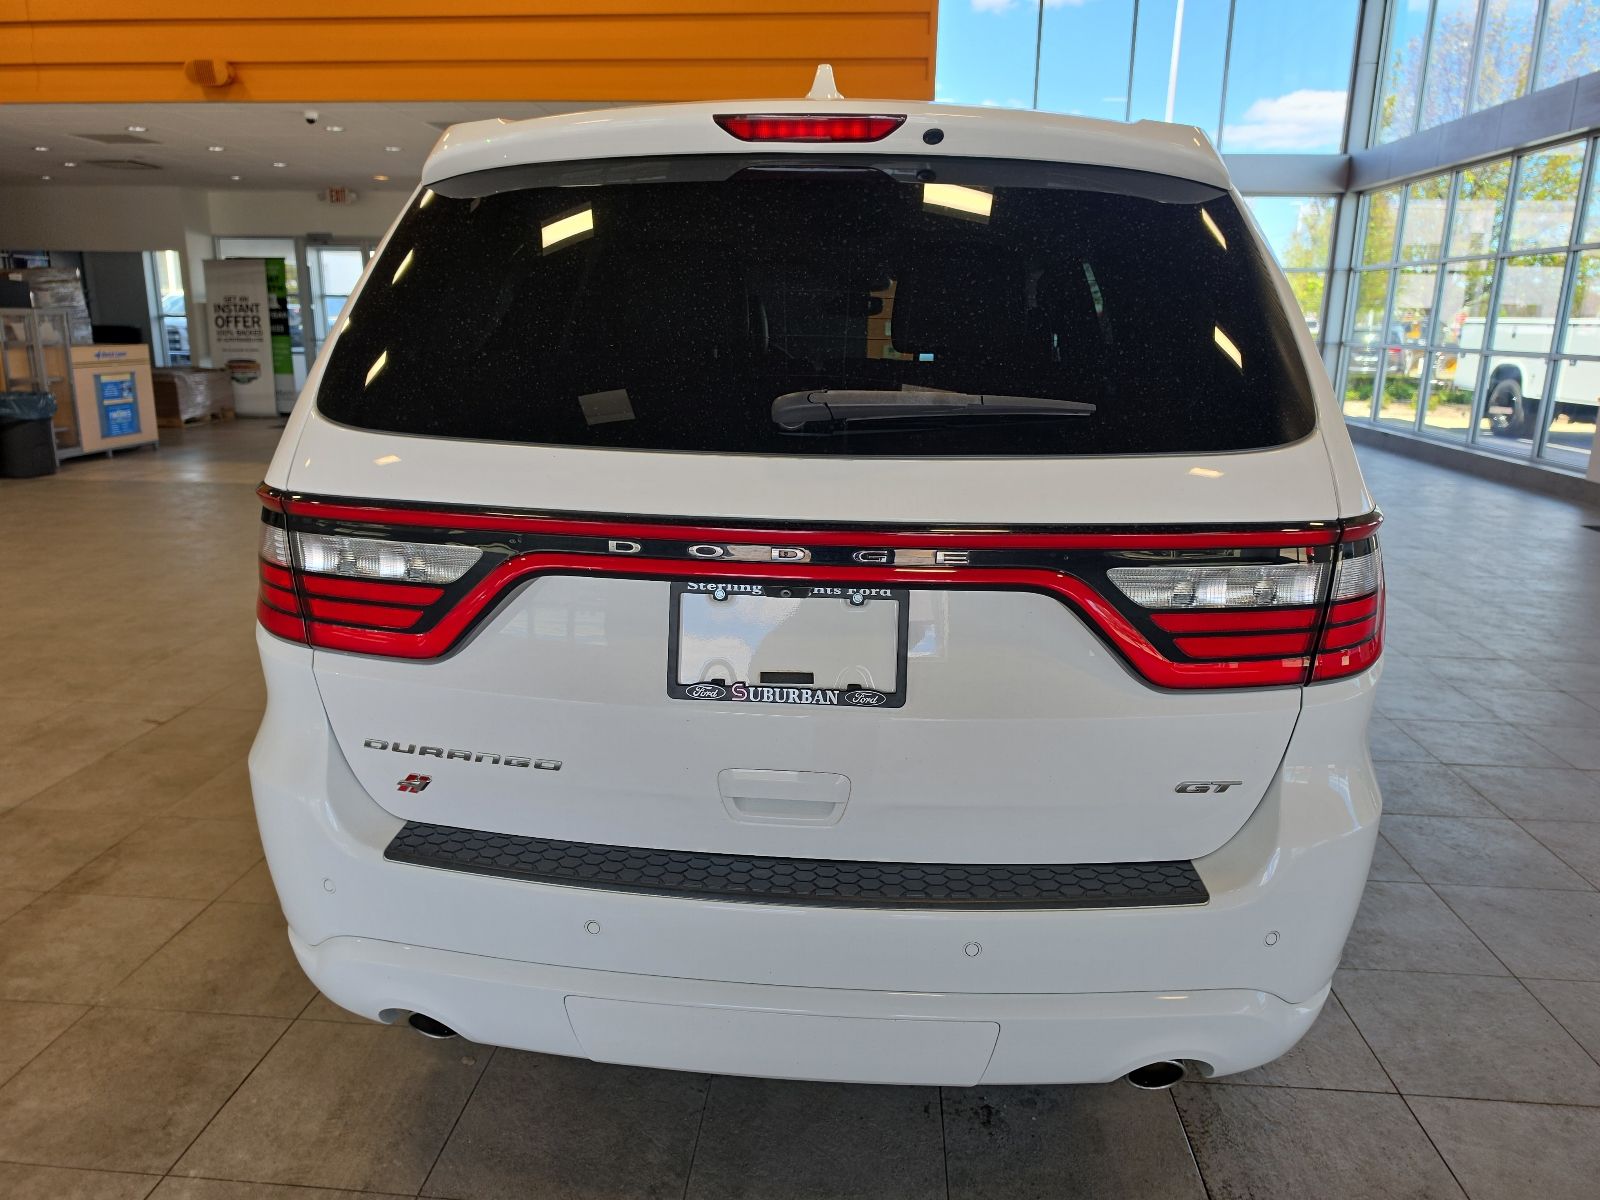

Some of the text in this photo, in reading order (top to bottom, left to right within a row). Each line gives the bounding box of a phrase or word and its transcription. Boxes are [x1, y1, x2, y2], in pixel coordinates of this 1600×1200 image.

[214, 303, 260, 313] INSTANT
[215, 315, 261, 329] OFFER
[608, 539, 968, 565] DODGE
[691, 685, 721, 699] Ford
[731, 683, 839, 705] SUBURBAN
[851, 692, 880, 705] Ford
[363, 738, 563, 771] DURANGO
[1174, 780, 1243, 793] GT
